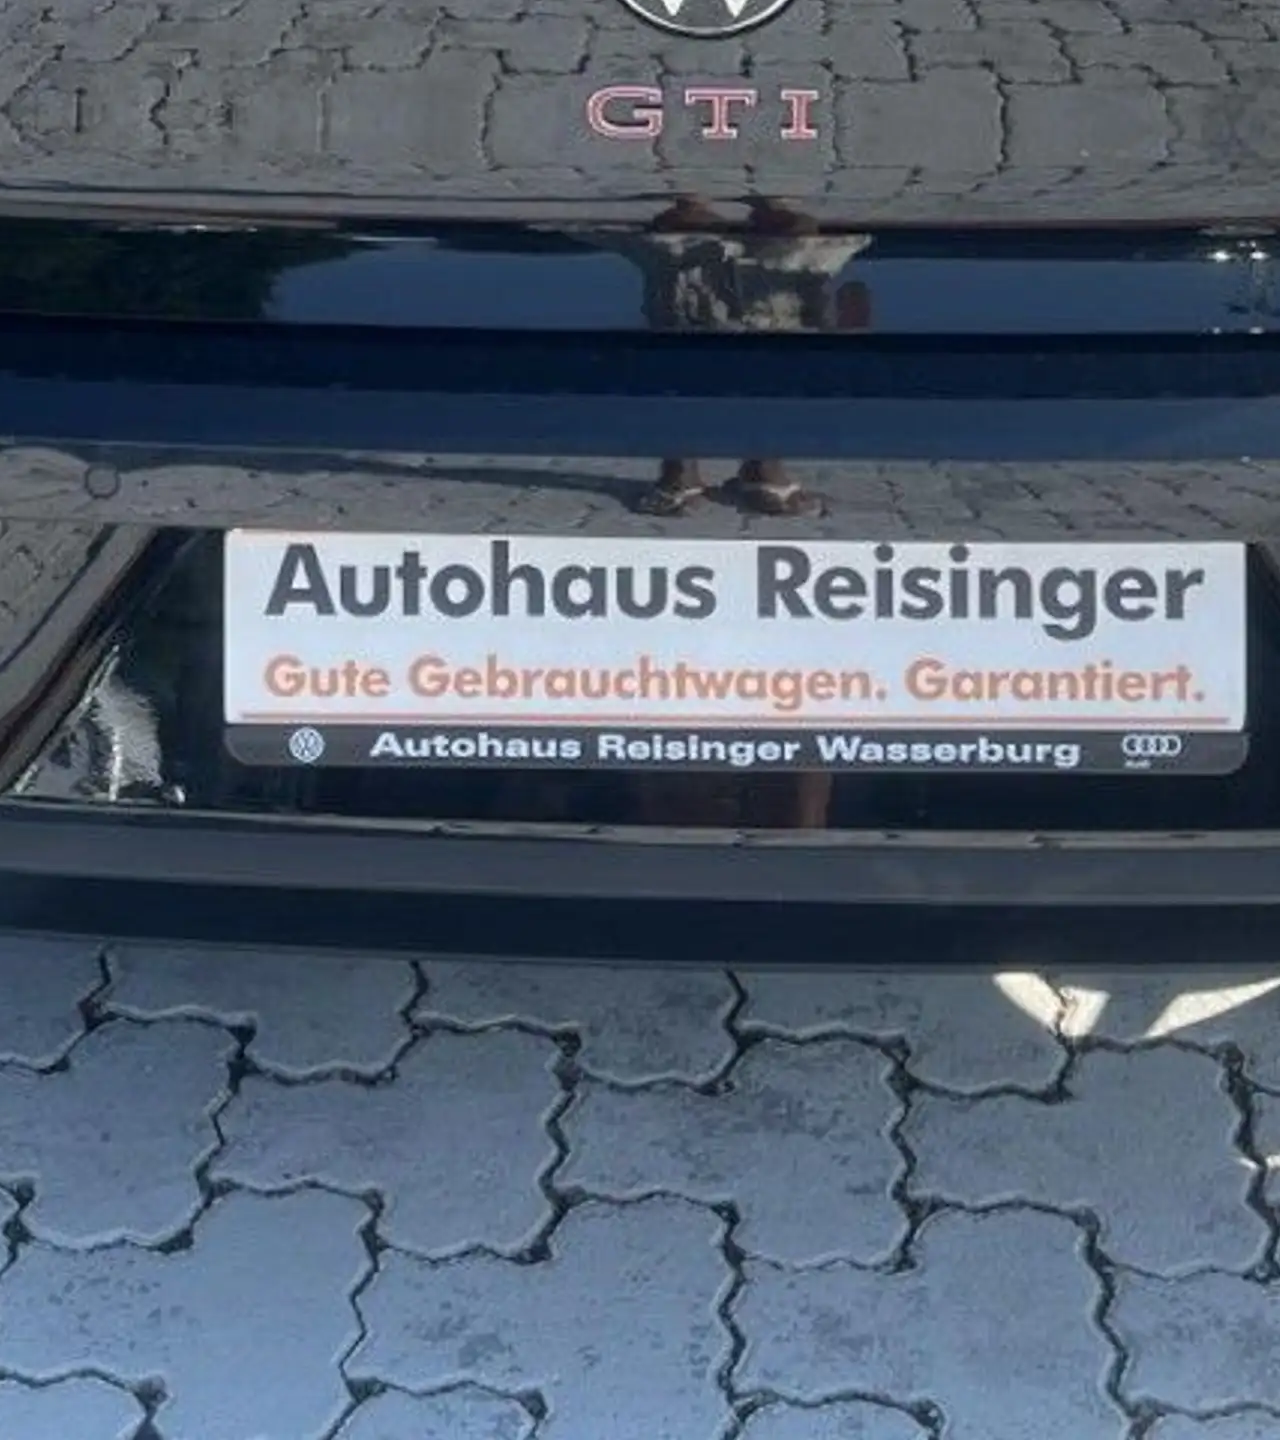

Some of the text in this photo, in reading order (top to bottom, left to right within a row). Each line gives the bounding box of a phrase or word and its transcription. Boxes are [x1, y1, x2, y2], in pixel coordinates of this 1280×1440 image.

[587, 86, 819, 139] GTI
[263, 540, 1205, 641] Autohaus Reisinger
[263, 654, 1206, 711] Gute Gebrauchtwagen. Garantiert.
[369, 731, 1082, 768] Autohaus Reisinger Wasserburg
